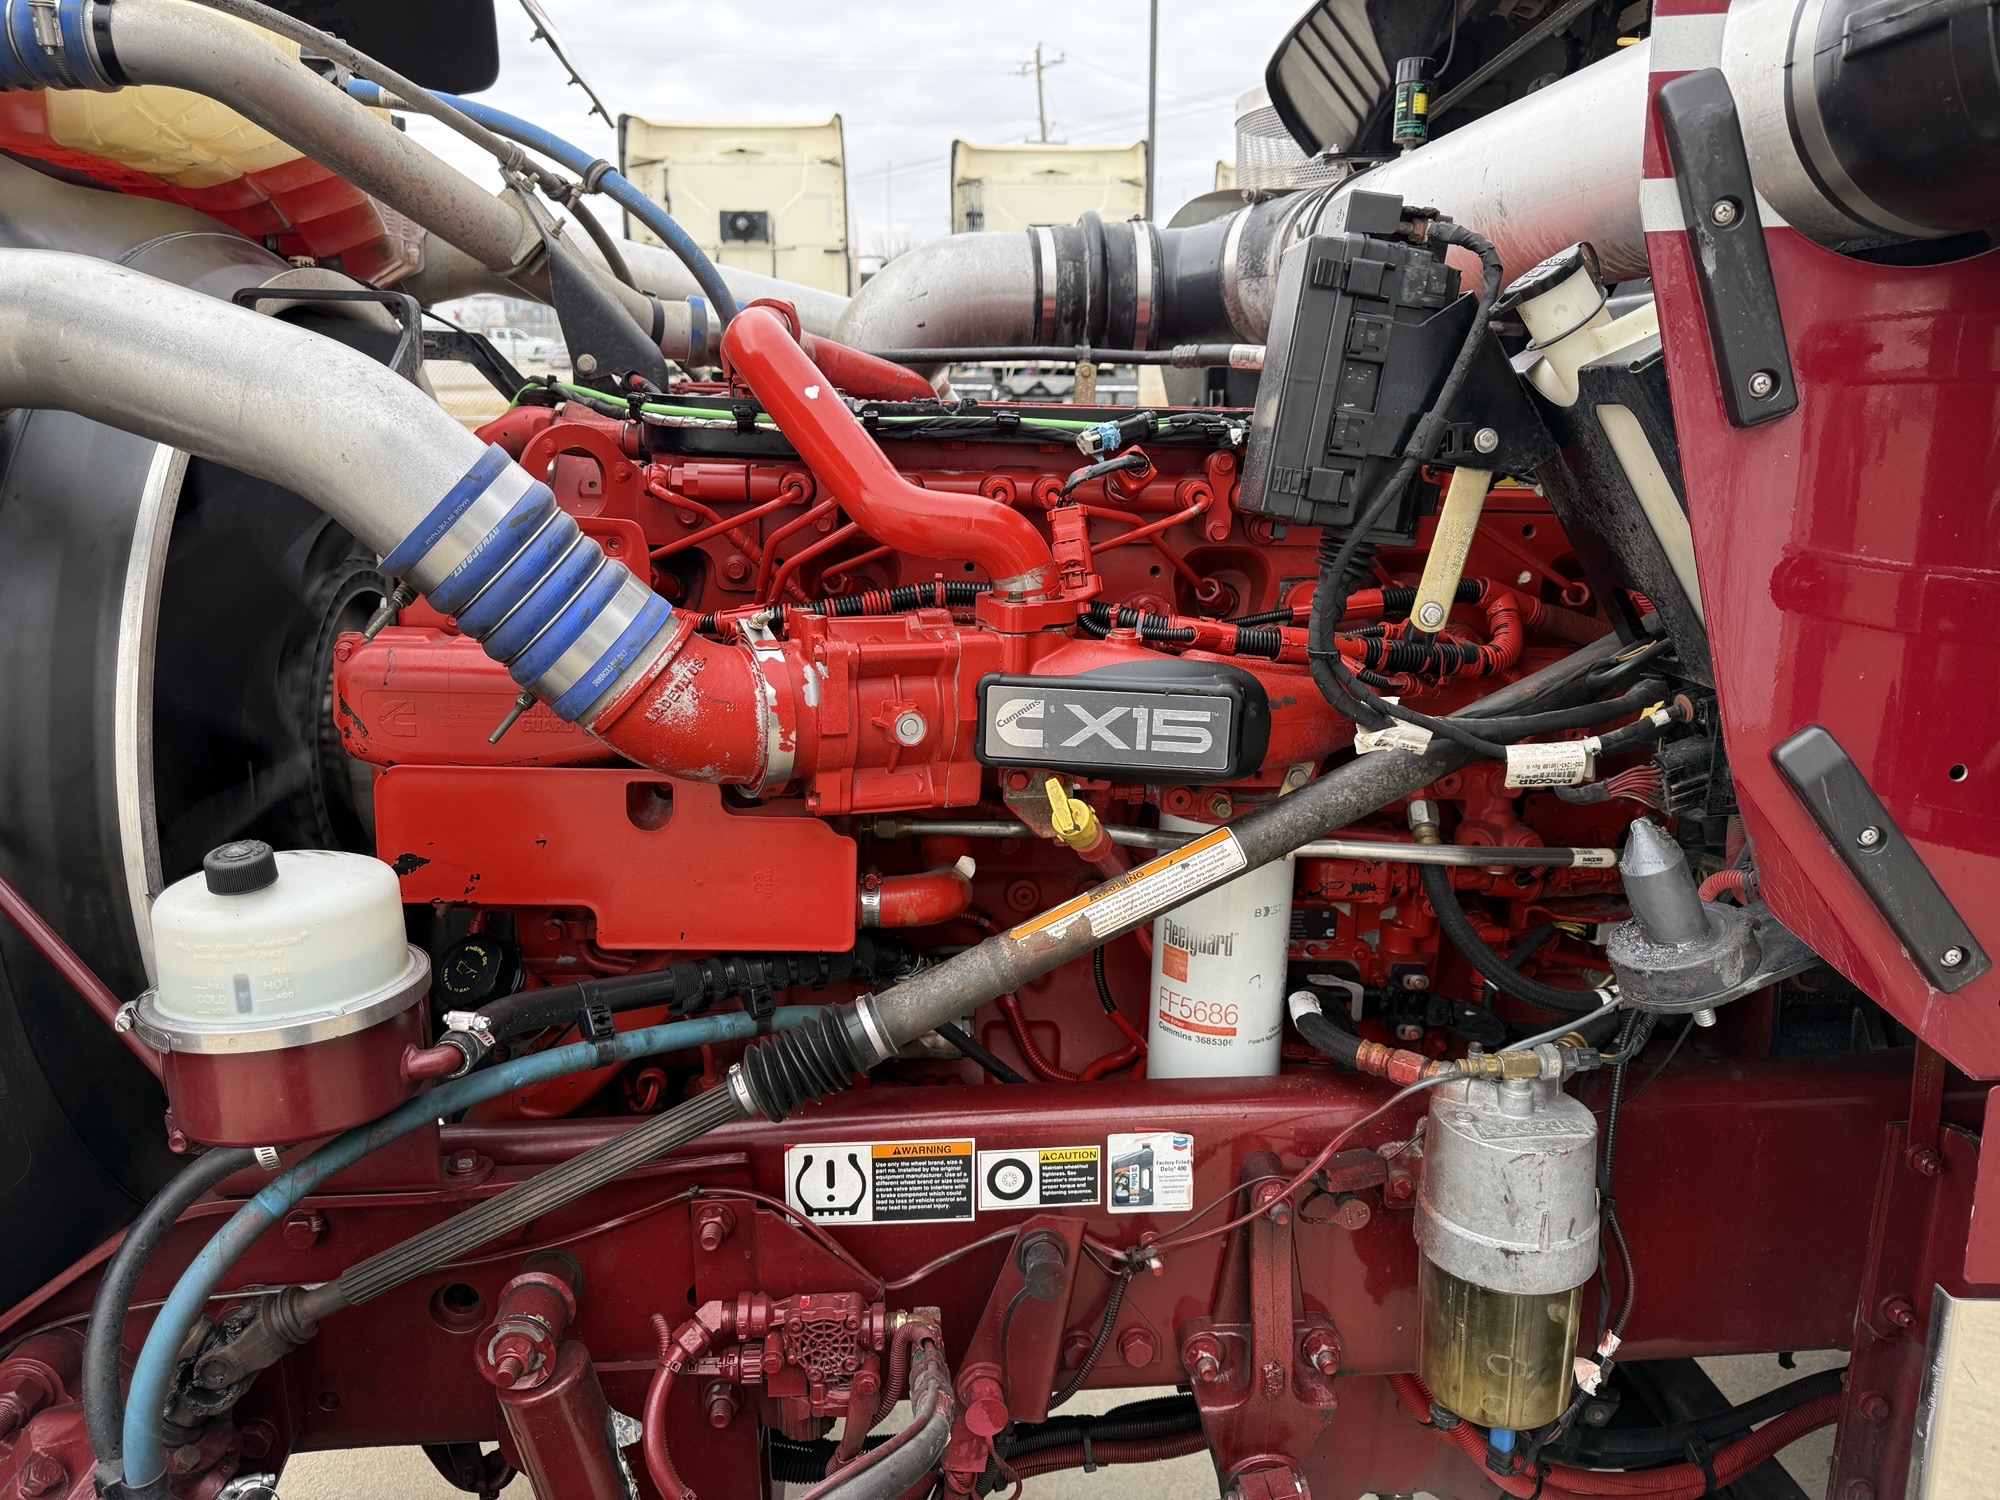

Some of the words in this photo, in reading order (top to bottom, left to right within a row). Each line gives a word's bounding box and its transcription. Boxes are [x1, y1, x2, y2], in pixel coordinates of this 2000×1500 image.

[453, 497, 469, 515] MADE
[446, 513, 455, 521] IN
[424, 519, 449, 546] VIETNAM
[997, 700, 1040, 727] Cummins
[522, 720, 575, 733] GUARD
[1060, 704, 1212, 753] X15
[1096, 871, 1144, 897] WARING
[1164, 917, 1233, 957] Fleetguard
[465, 946, 486, 956] ENGINE
[264, 978, 291, 990] HOT
[198, 994, 226, 1004] COLD
[277, 992, 294, 1000] ADD
[1159, 986, 1238, 1025] FF5686
[1159, 1021, 1192, 1041] Cummins
[901, 1145, 952, 1154] WARNING
[1050, 1151, 1096, 1160] CAUTION
